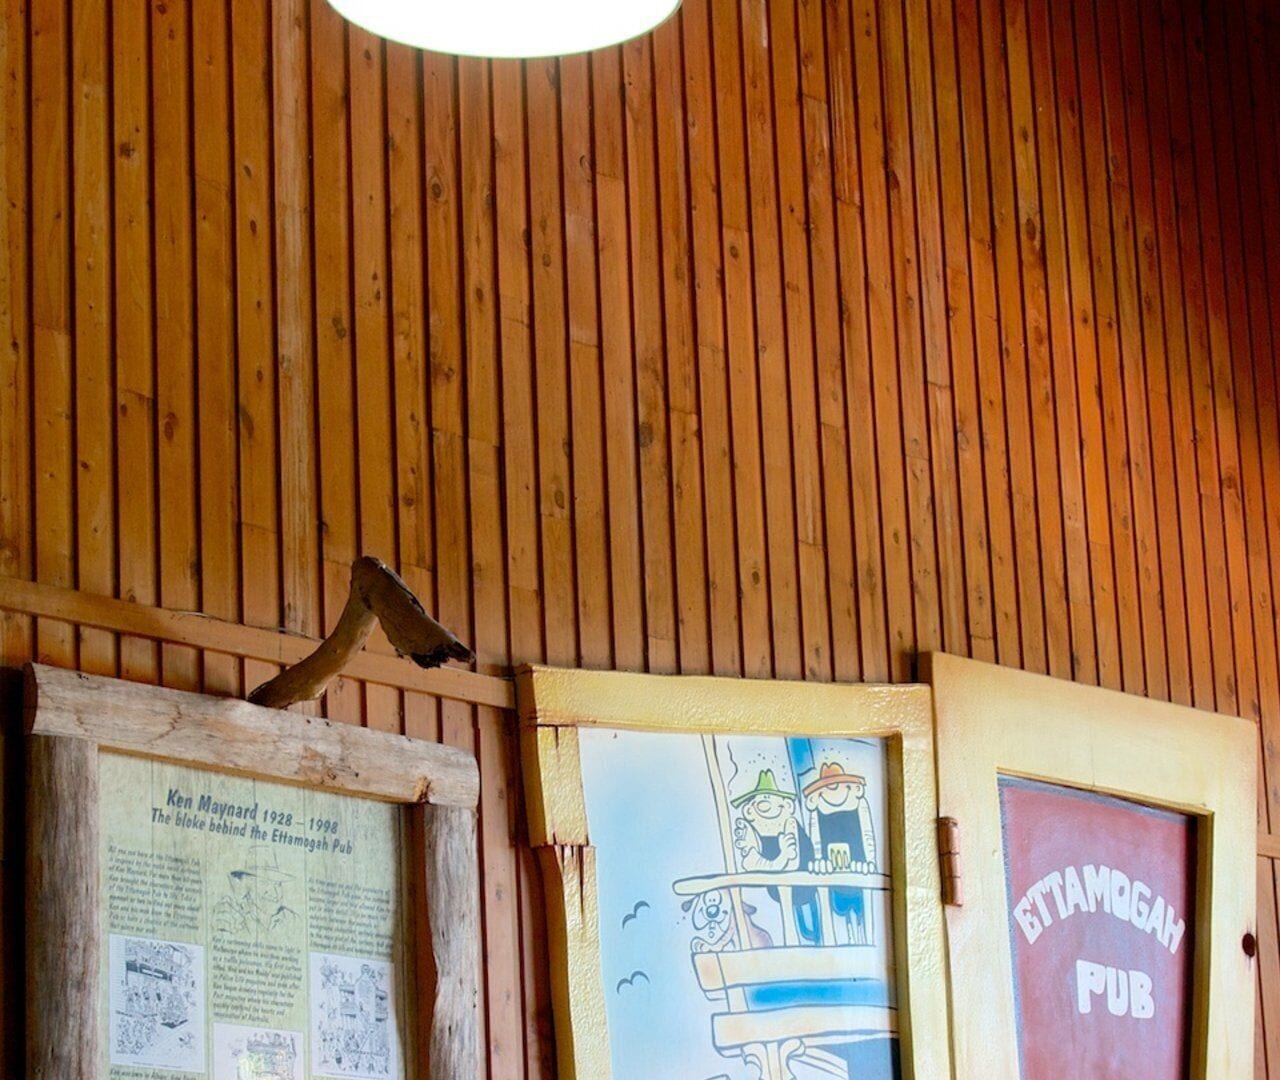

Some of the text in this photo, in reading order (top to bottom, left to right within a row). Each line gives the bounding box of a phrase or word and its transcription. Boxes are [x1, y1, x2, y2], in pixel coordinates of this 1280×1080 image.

[151, 807, 353, 856] The bloke behind the Ettamogah Pub
[166, 789, 193, 810] Ken
[197, 794, 258, 821] Maynard
[263, 809, 293, 827] 1928
[309, 818, 339, 834] 1998
[1013, 864, 1186, 955] ETTAMOGAH
[1076, 959, 1155, 1019] PUB
